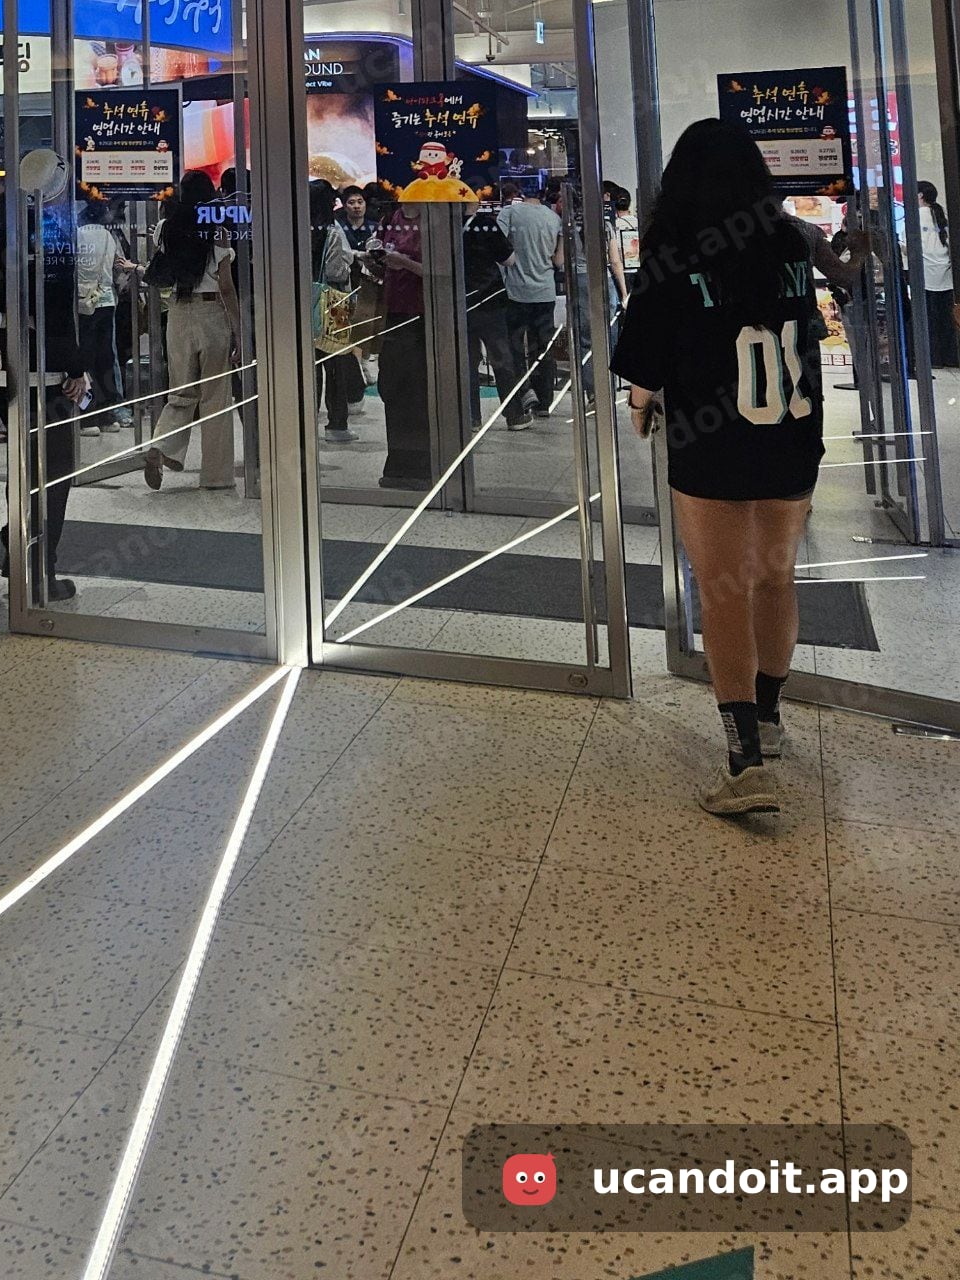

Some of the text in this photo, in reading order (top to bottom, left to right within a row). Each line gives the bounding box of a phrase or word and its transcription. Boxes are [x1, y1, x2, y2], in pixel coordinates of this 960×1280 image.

[751, 81, 810, 105] 추석 연휴
[103, 100, 150, 121] 추석 연휴
[391, 111, 422, 129] 즐기는
[424, 108, 450, 128] 추석
[740, 105, 824, 124] 영업시간 안내
[92, 120, 161, 136] 영업시간 안내
